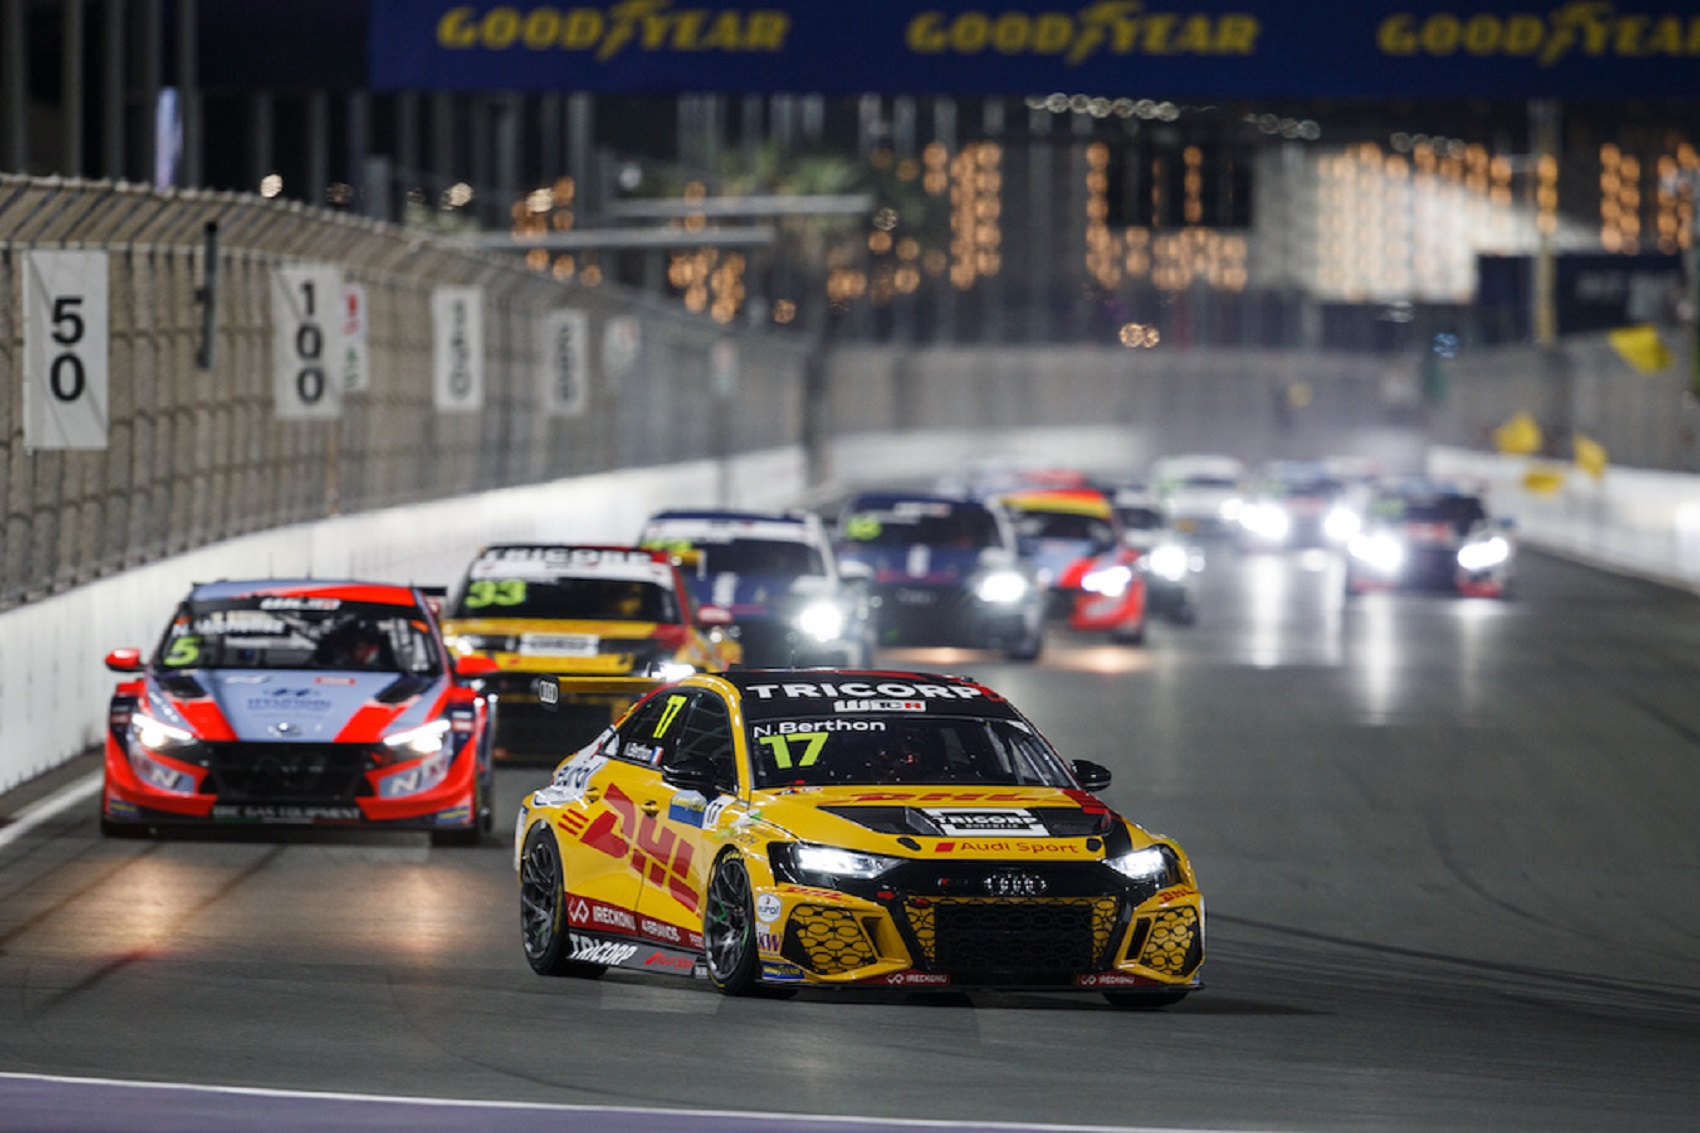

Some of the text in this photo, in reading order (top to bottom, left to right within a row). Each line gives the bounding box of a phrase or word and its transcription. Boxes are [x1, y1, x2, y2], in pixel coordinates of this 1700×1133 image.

[436, 4, 791, 60] GOODYEAR
[905, 4, 1260, 62] GOODYEAR
[50, 296, 86, 403] 50
[295, 281, 326, 406] 100
[464, 580, 527, 608] 33
[163, 637, 202, 667] 5
[746, 682, 982, 699] TRICORP
[652, 695, 688, 739] 17
[753, 719, 887, 738] N.Berthon
[759, 731, 829, 770] 17
[932, 814, 1038, 825] TRICORP
[580, 782, 699, 912] DHL
[960, 841, 1080, 854] Audi Sport
